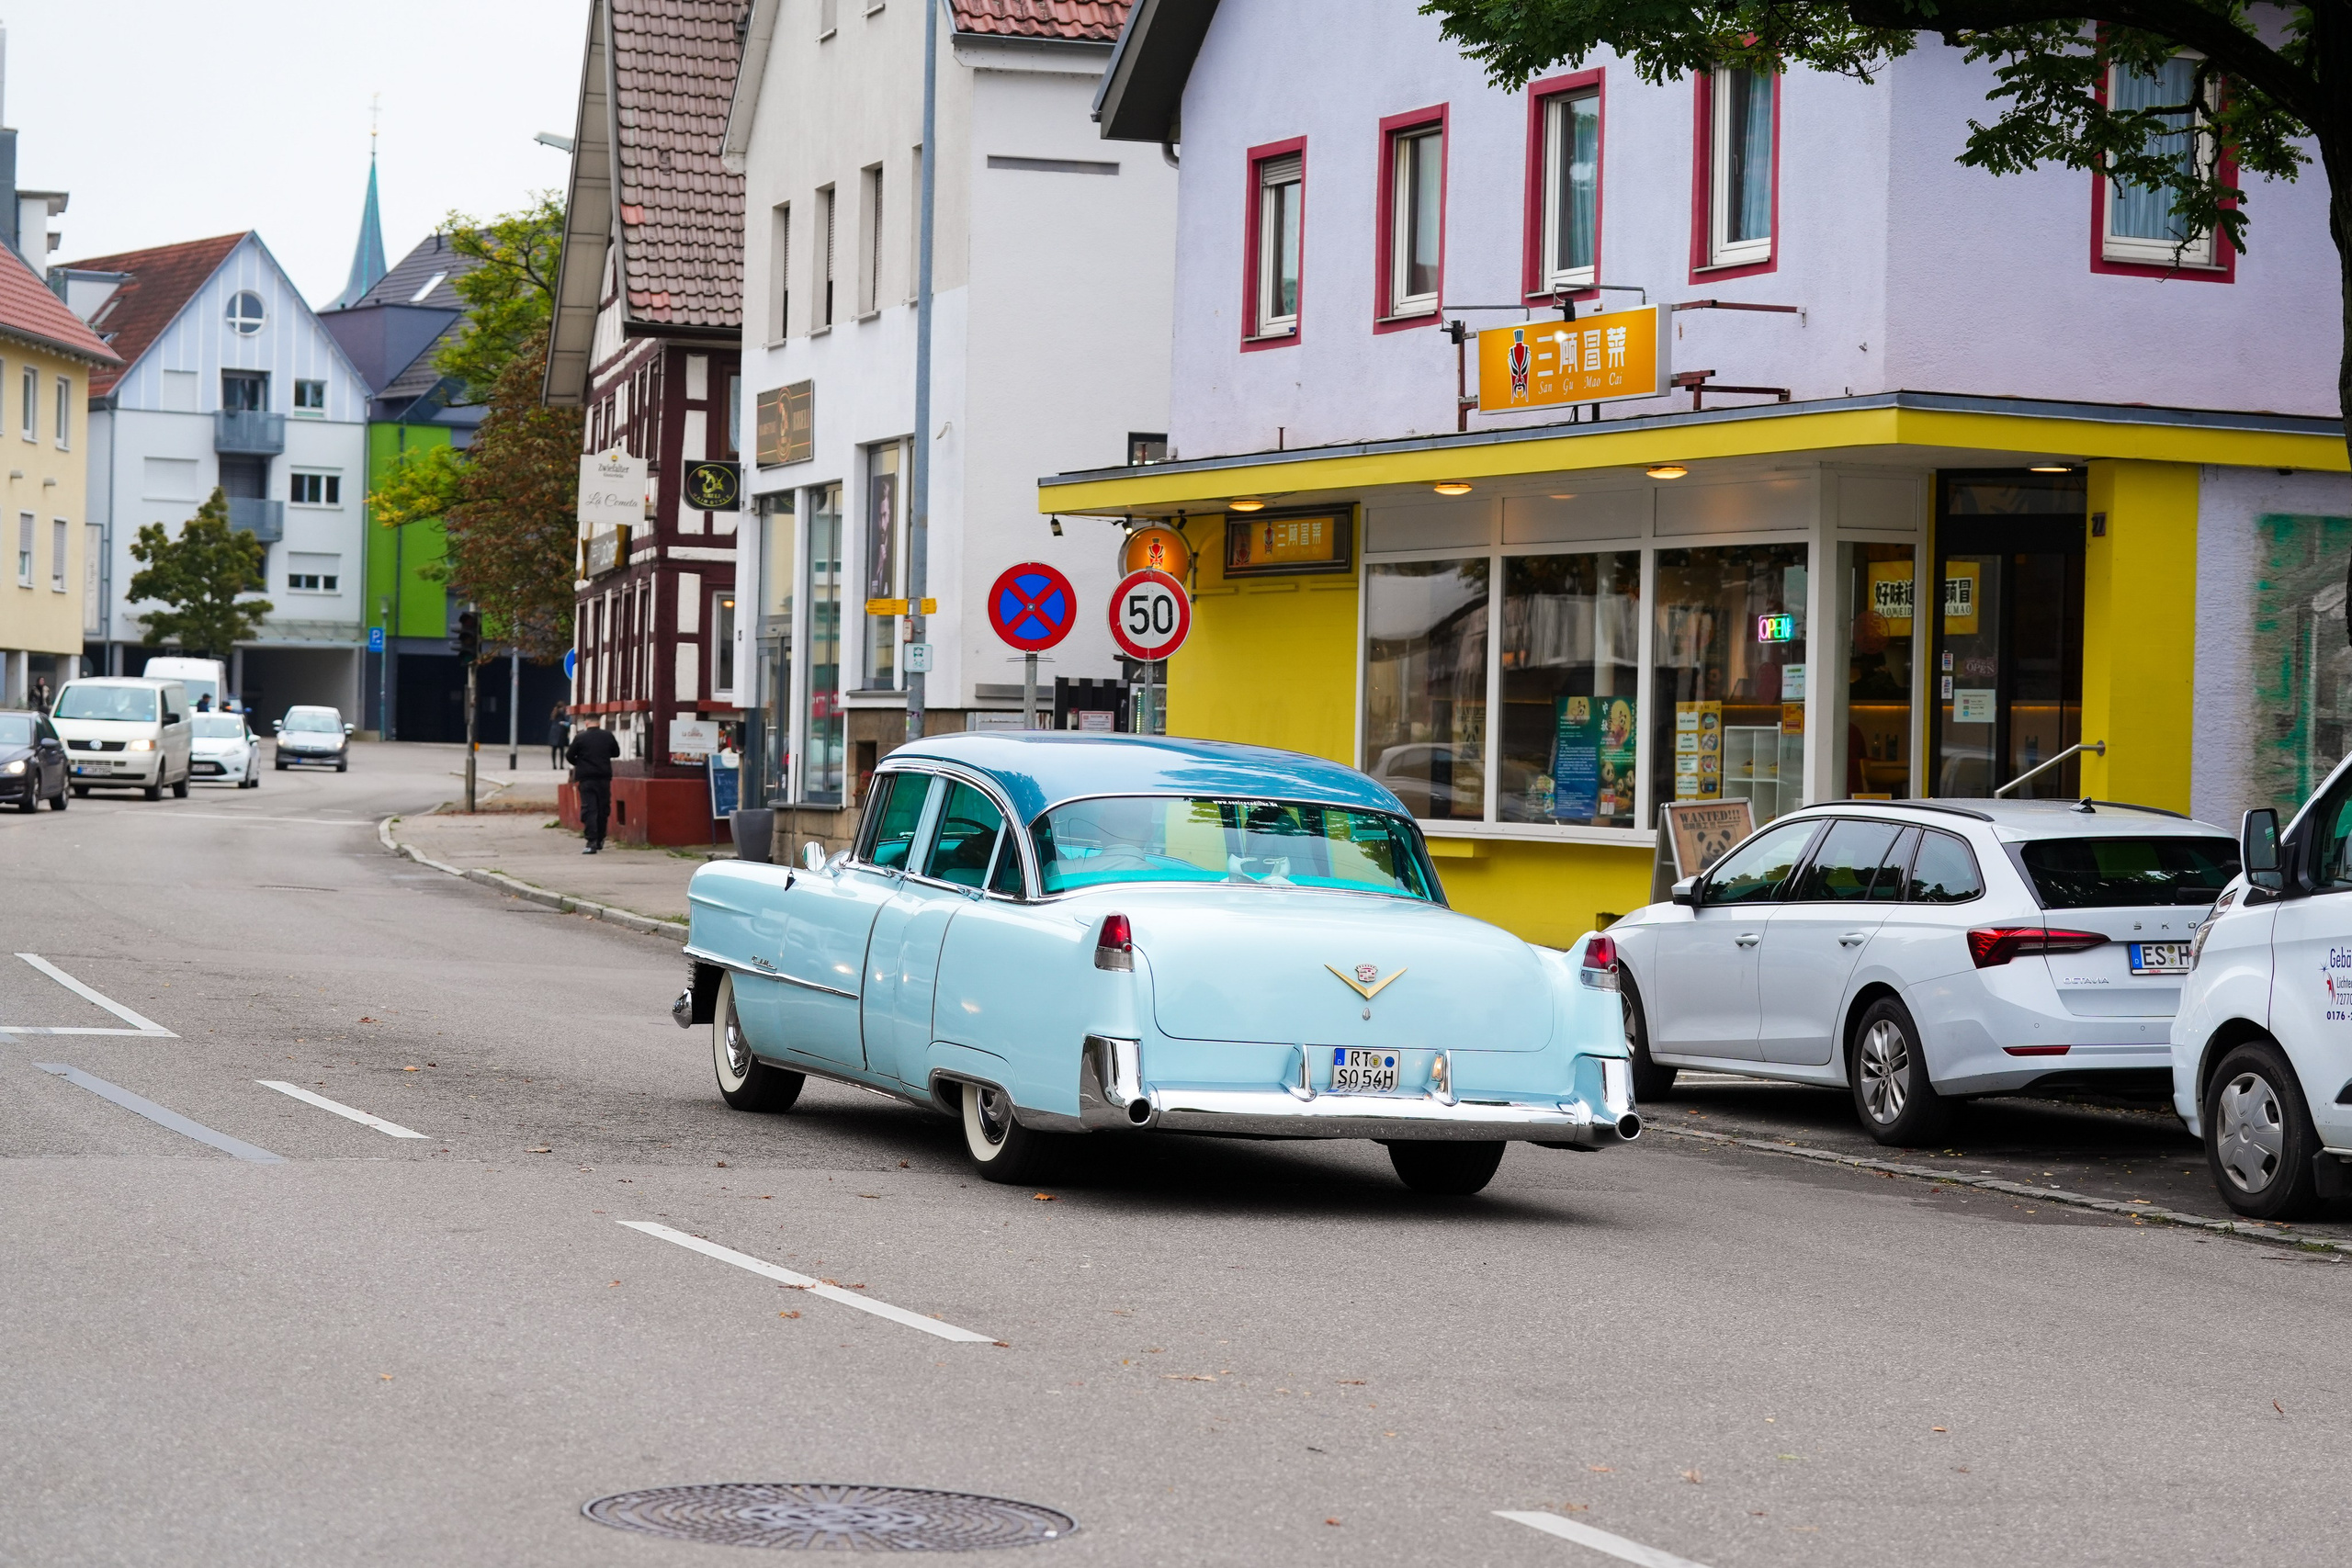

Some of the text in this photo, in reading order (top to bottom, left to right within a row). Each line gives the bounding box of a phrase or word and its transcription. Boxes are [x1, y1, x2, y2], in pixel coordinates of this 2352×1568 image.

[1538, 371, 1623, 395] San Gu Mao Cai
[585, 491, 639, 509] La Cometa
[1128, 594, 1174, 635] 50
[372, 630, 380, 642] P
[1759, 618, 1790, 639] OPEN
[1966, 662, 1995, 675] OPEN
[1679, 809, 1741, 823] WANTED!!!
[2143, 945, 2189, 965] ES H
[2330, 946, 2352, 968] Gebä
[2064, 976, 2109, 985] OCTAVIA
[2336, 976, 2352, 988] Lichte
[2327, 1011, 2345, 1021] 0176
[1351, 1051, 1371, 1066] RT
[1338, 1068, 1394, 1085] SO 54H
